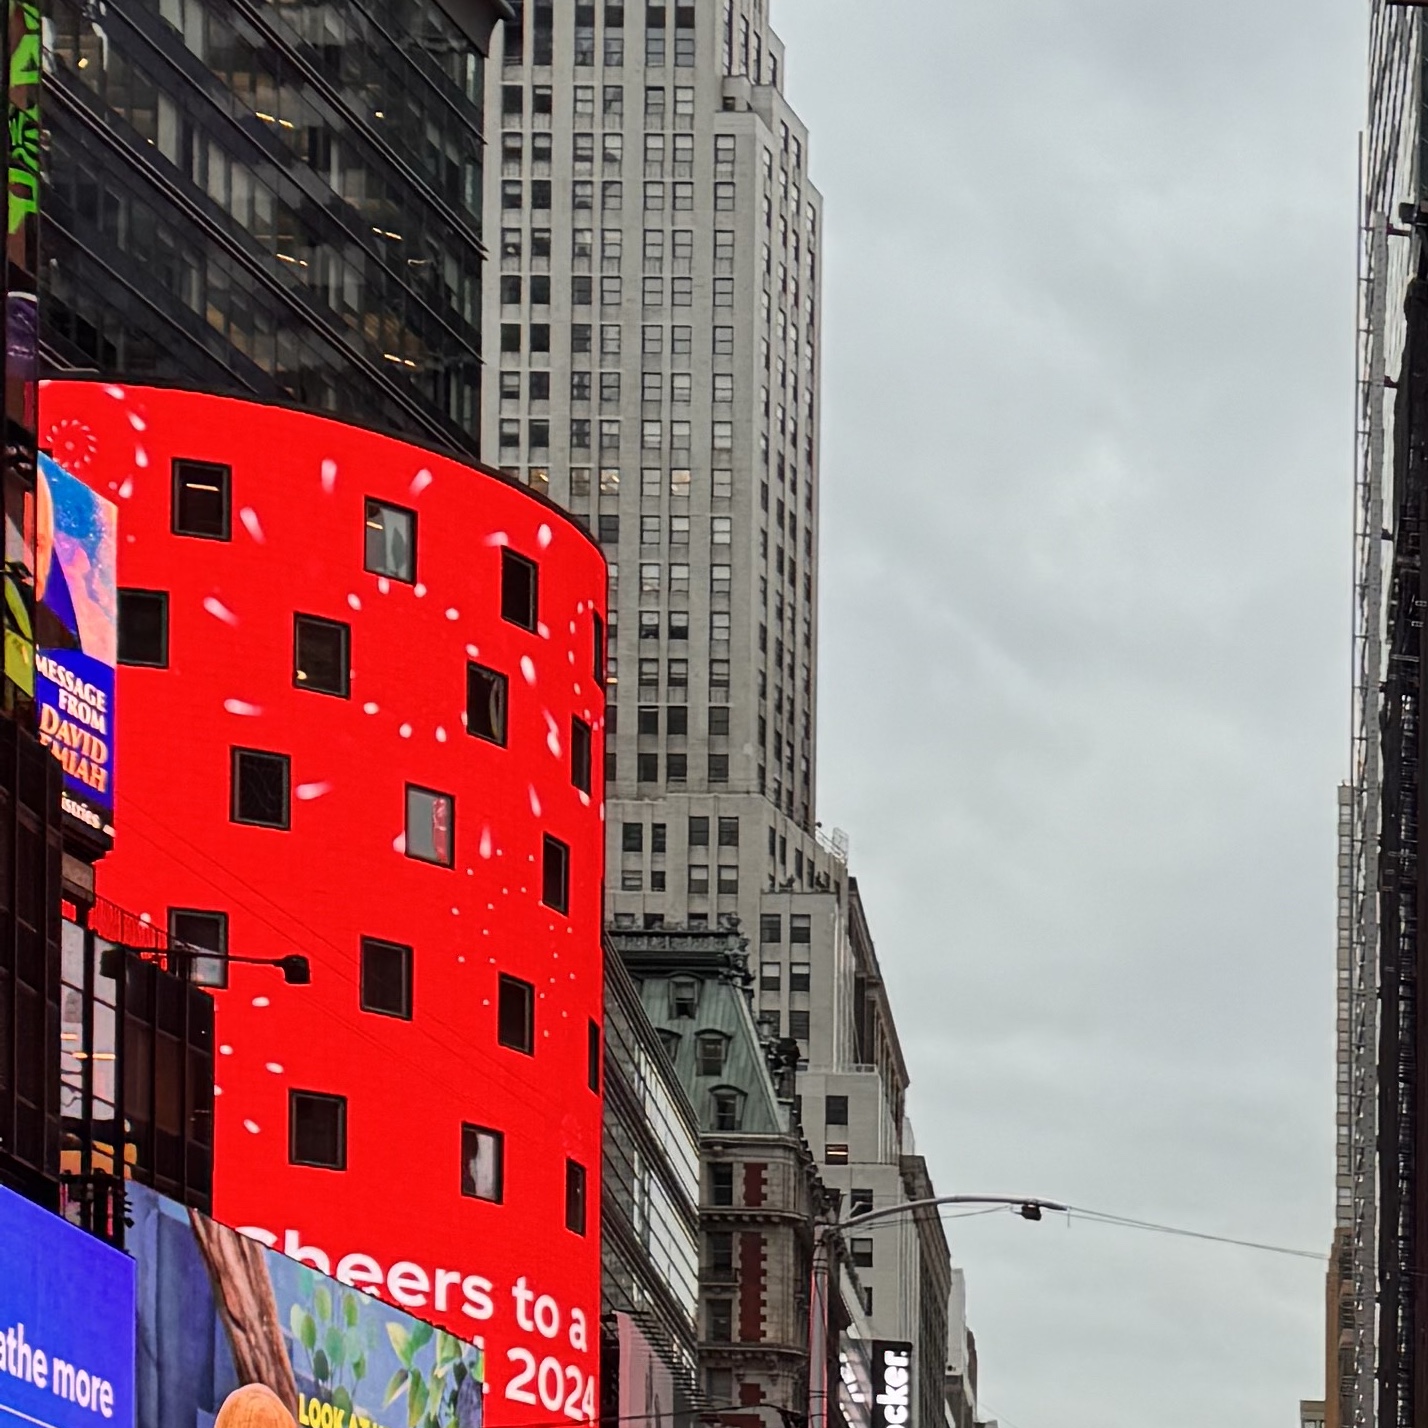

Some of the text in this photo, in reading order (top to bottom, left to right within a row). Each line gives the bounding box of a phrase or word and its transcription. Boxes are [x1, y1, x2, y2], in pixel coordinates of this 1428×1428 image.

[39, 702, 109, 765] DAVID
[58, 688, 107, 735] FROM
[235, 1225, 587, 1353] heers to a
[52, 1357, 115, 1419] more
[505, 1347, 596, 1428] 2024
